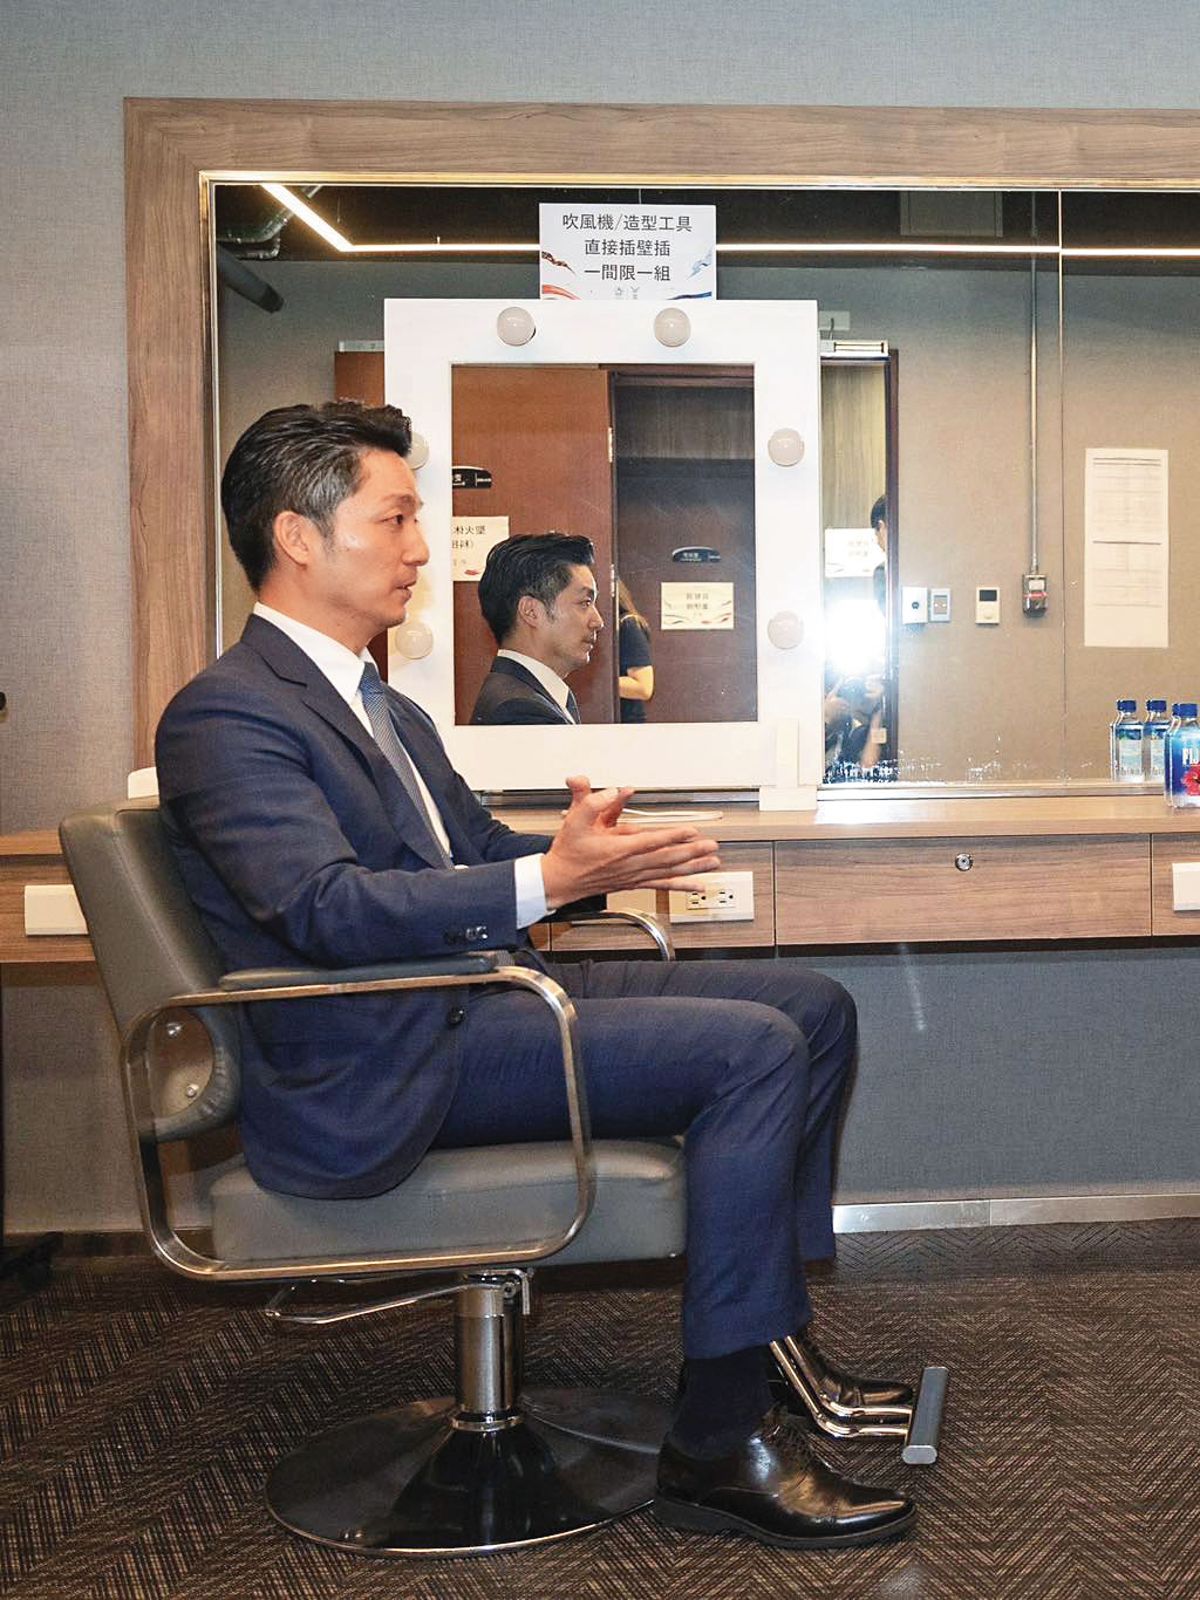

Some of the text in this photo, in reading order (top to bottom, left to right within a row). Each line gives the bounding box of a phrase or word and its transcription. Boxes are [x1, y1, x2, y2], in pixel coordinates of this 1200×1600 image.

[562, 213, 693, 233] 吹風機/造型工具
[584, 239, 671, 257] 直接插壁插
[584, 264, 671, 281] 一間限一組
